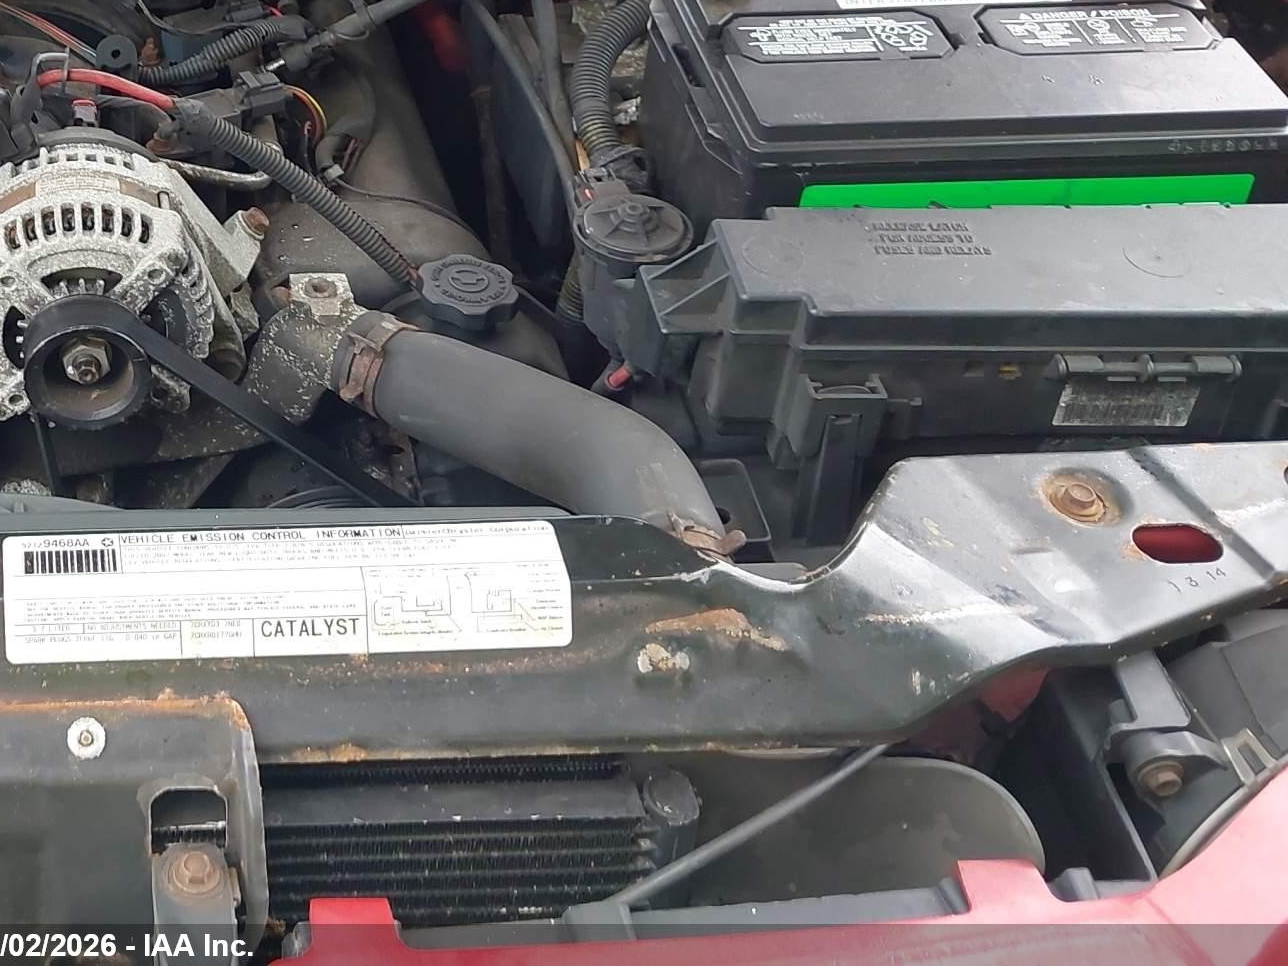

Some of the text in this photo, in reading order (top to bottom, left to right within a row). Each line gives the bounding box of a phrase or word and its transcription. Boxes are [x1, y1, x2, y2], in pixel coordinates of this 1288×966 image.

[1032, 10, 1088, 21] DANGER
[1097, 8, 1150, 19] POISON
[121, 528, 401, 544] VEHICLE EMISSION CONTROL INFORMATION
[261, 617, 360, 639] CATALYST
[163, 632, 178, 640] GAP
